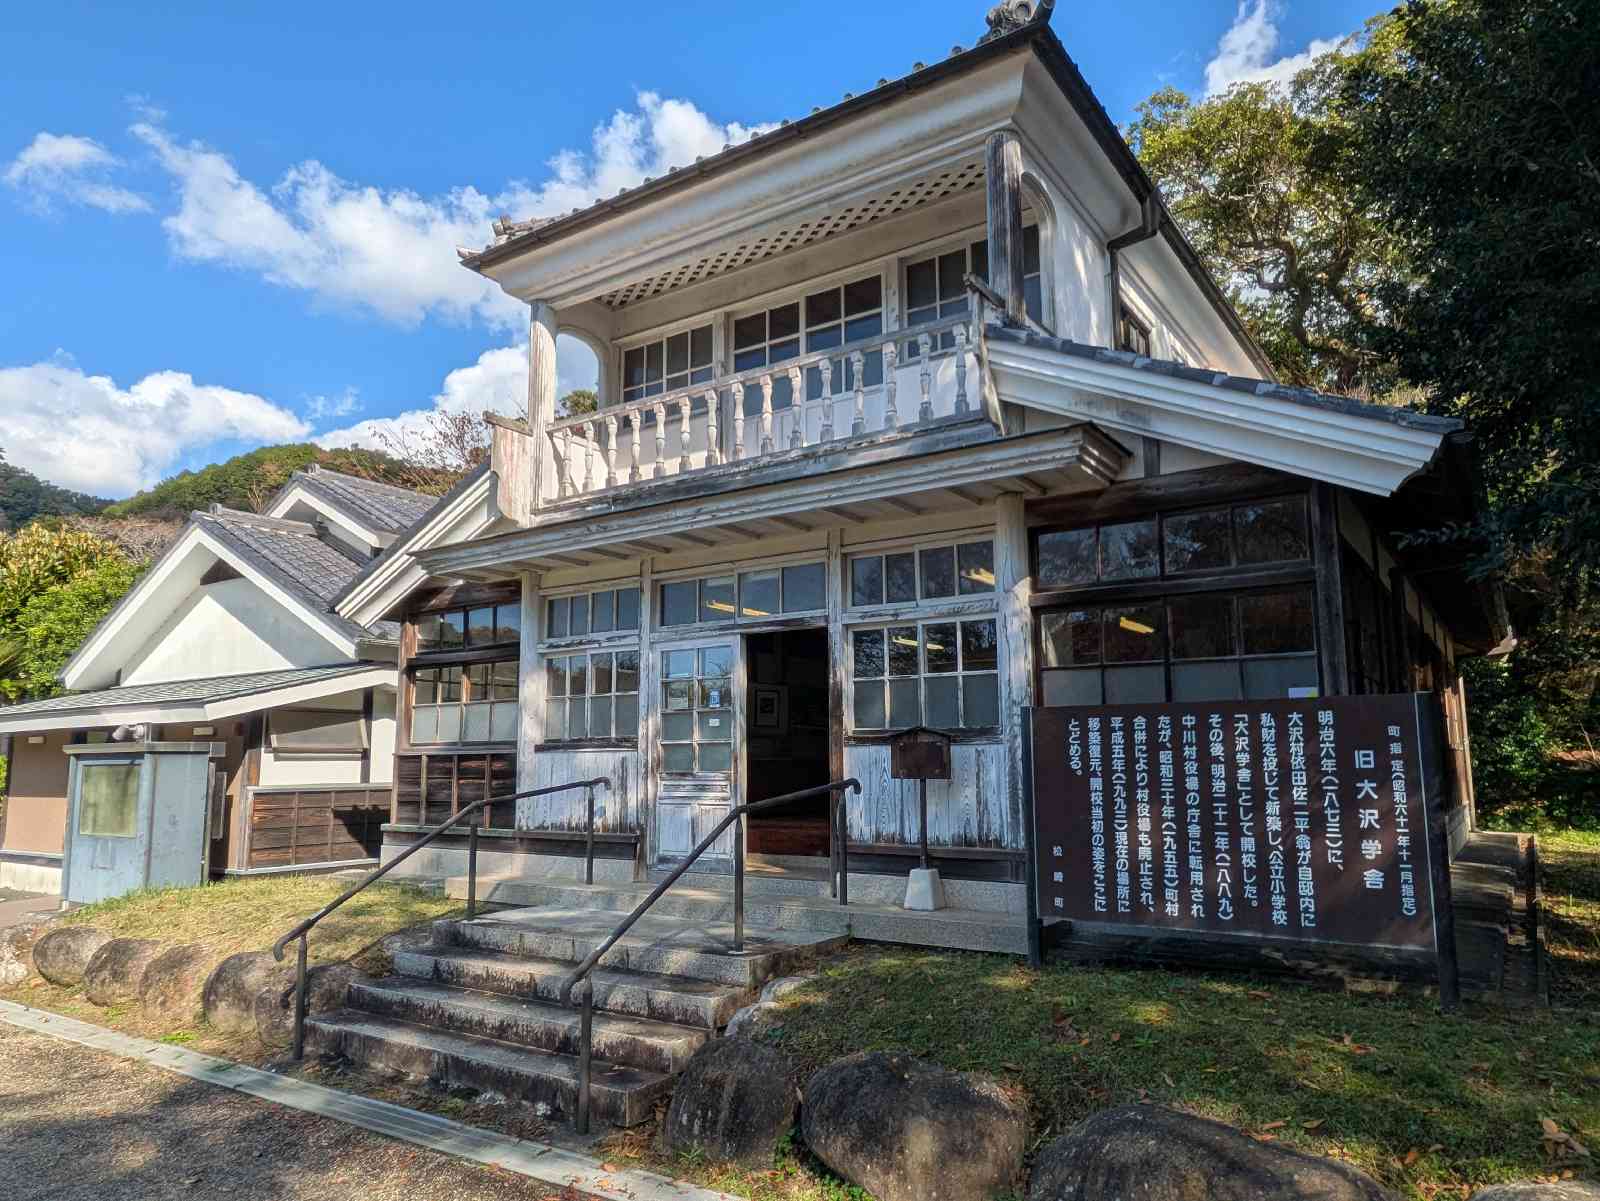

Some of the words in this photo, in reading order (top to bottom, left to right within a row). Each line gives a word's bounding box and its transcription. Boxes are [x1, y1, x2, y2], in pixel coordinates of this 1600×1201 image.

[1068, 718, 1083, 776] とどめる。
[1318, 710, 1344, 871] 明治六年（一八七三）に、
[1354, 750, 1384, 889] 旧大沢学舎
